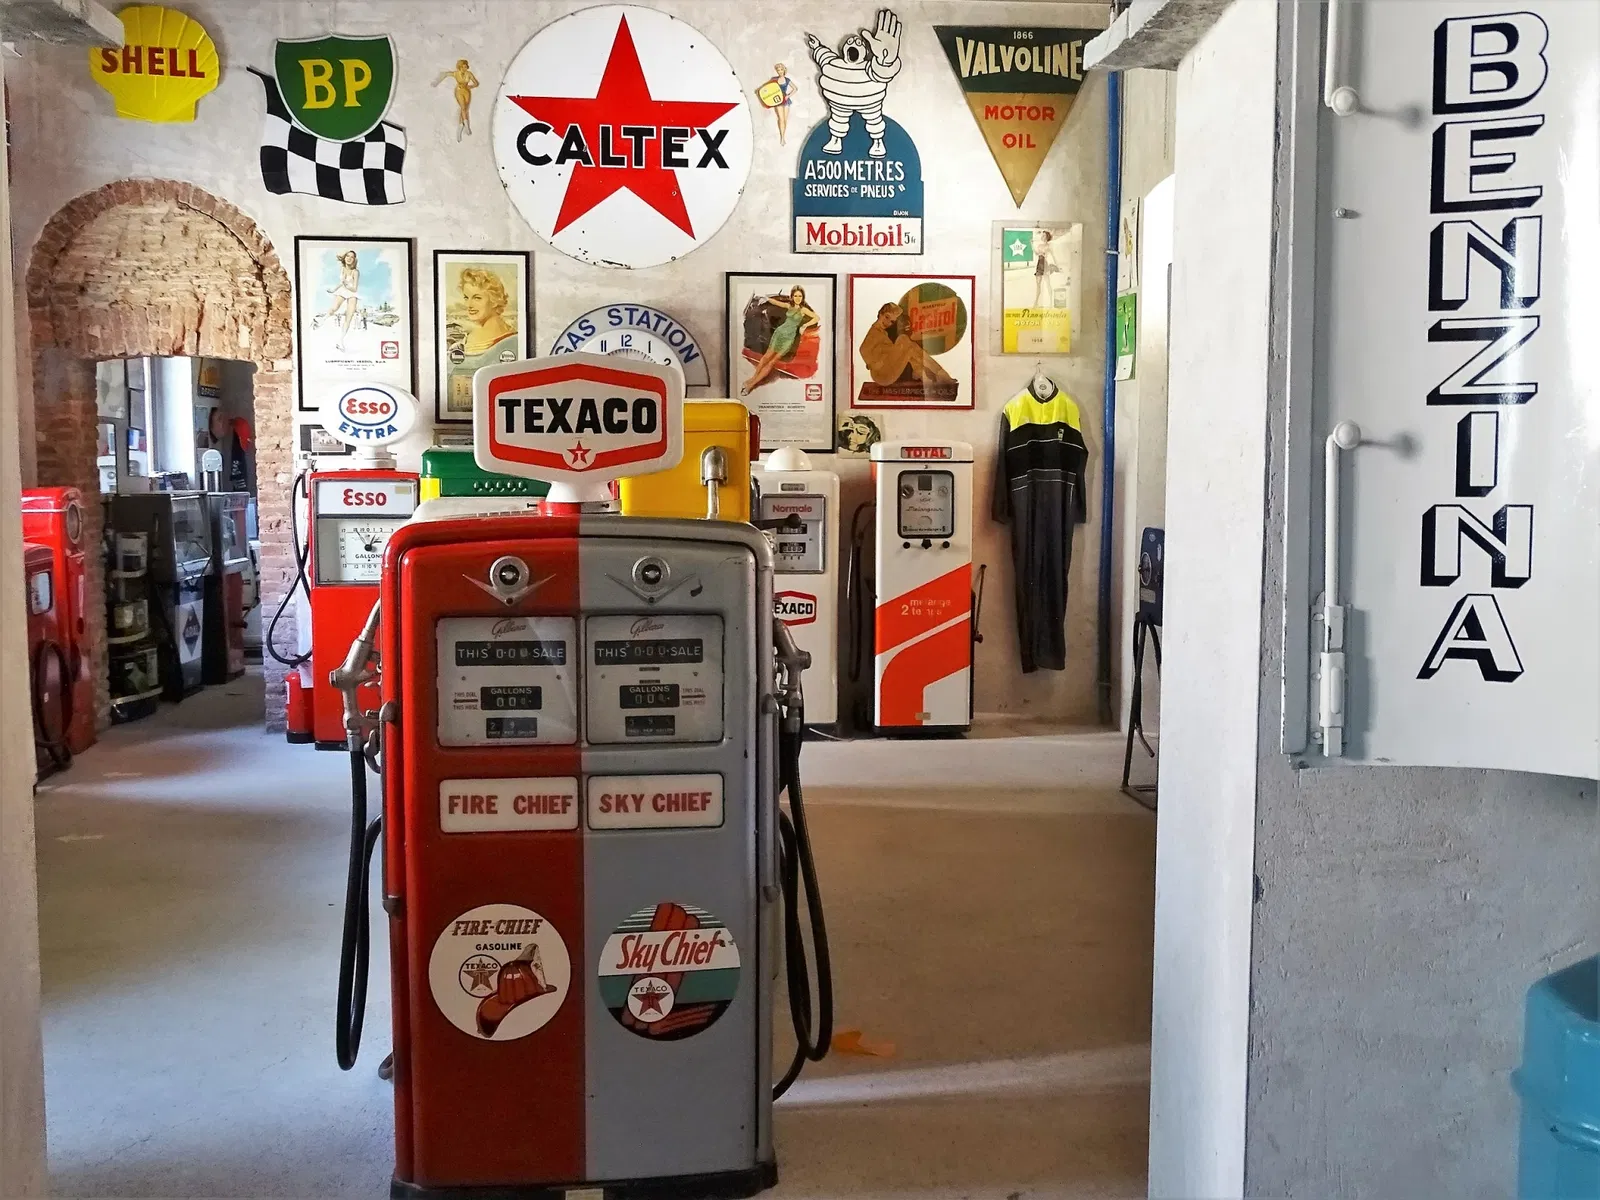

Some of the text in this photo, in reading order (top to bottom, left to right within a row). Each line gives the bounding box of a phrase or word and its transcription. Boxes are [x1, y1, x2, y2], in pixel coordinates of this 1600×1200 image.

[1013, 31, 1034, 40] 1866
[101, 44, 206, 78] SHELL
[955, 36, 1083, 82] VALVOLINE
[298, 59, 372, 109] BP
[984, 105, 1056, 121] MOTOR
[516, 122, 730, 169] CALTEX
[1002, 134, 1037, 149] OIL
[844, 160, 905, 181] METRES
[804, 184, 850, 197] SERVICES
[860, 184, 895, 198] PNEUS
[806, 222, 904, 247] Mobiloil
[607, 308, 700, 364] STATION
[621, 334, 632, 347] 12
[600, 340, 607, 352] 11
[647, 340, 652, 353] 1
[1416, 11, 1549, 683] BENZINA
[346, 398, 391, 415] Esso
[498, 397, 657, 434] TEXACO
[338, 421, 398, 439] EXTRA
[905, 448, 947, 458] TOTAL
[343, 488, 387, 506] Esso
[774, 602, 813, 614] EXACO
[901, 604, 909, 616] 2
[457, 649, 489, 659] THIS
[532, 648, 565, 658] SALE
[597, 648, 628, 658] THIS
[670, 646, 701, 657] SALE
[490, 687, 533, 695] GALLONS
[629, 685, 670, 693] GALLONS
[449, 795, 573, 814] FIRE CHIEF
[599, 792, 712, 813] SKY CHIEF
[452, 919, 543, 936] FIRE-CHIEF
[475, 942, 522, 951] GASOLINE
[616, 930, 722, 972] Sky Chief
[465, 962, 498, 970] TEXACO
[634, 985, 668, 993] TEXACO
